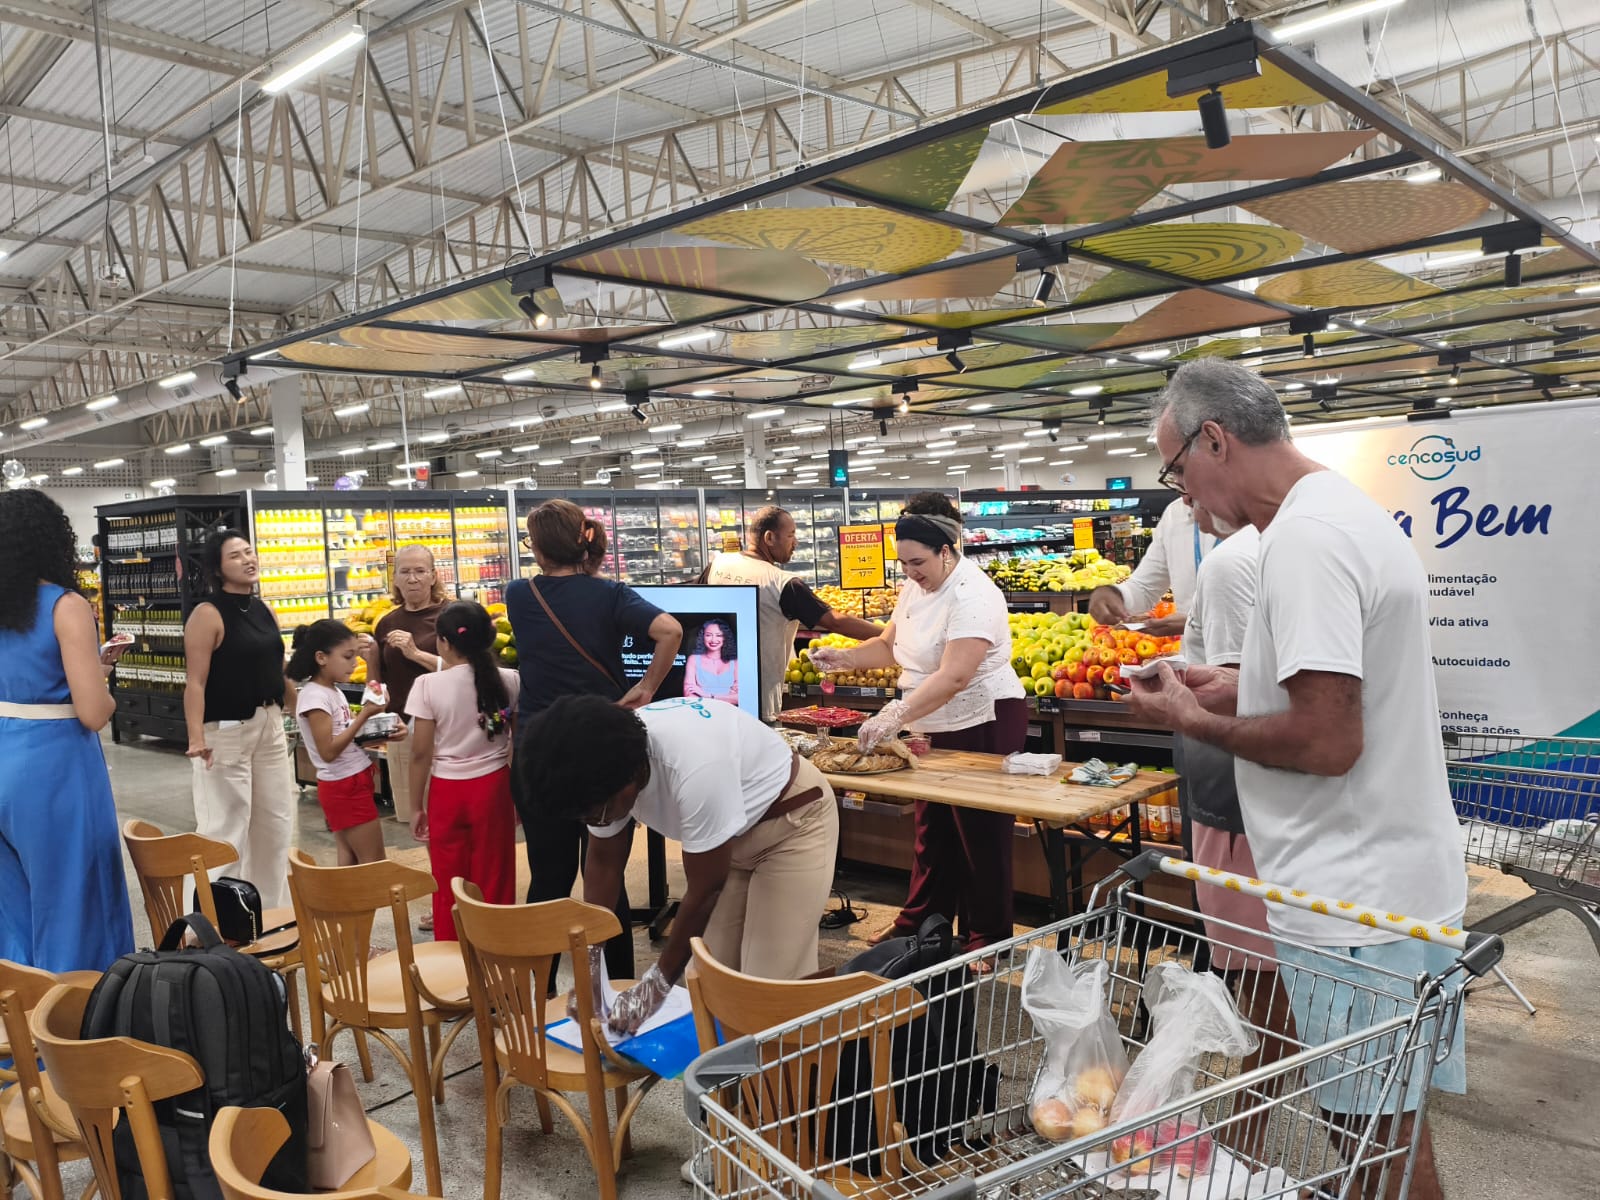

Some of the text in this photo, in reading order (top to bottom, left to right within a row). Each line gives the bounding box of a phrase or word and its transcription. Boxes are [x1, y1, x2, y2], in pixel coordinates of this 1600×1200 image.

[1387, 446, 1481, 466] cencosud
[1430, 486, 1552, 549] Bem
[844, 533, 878, 543] OFERTA
[1428, 574, 1497, 585] limentação
[1430, 587, 1475, 597] udável
[1429, 617, 1489, 627] Vida ativa
[1432, 656, 1511, 667] Autocuidado
[1438, 711, 1488, 722] onheça
[1441, 724, 1478, 733] ossas
